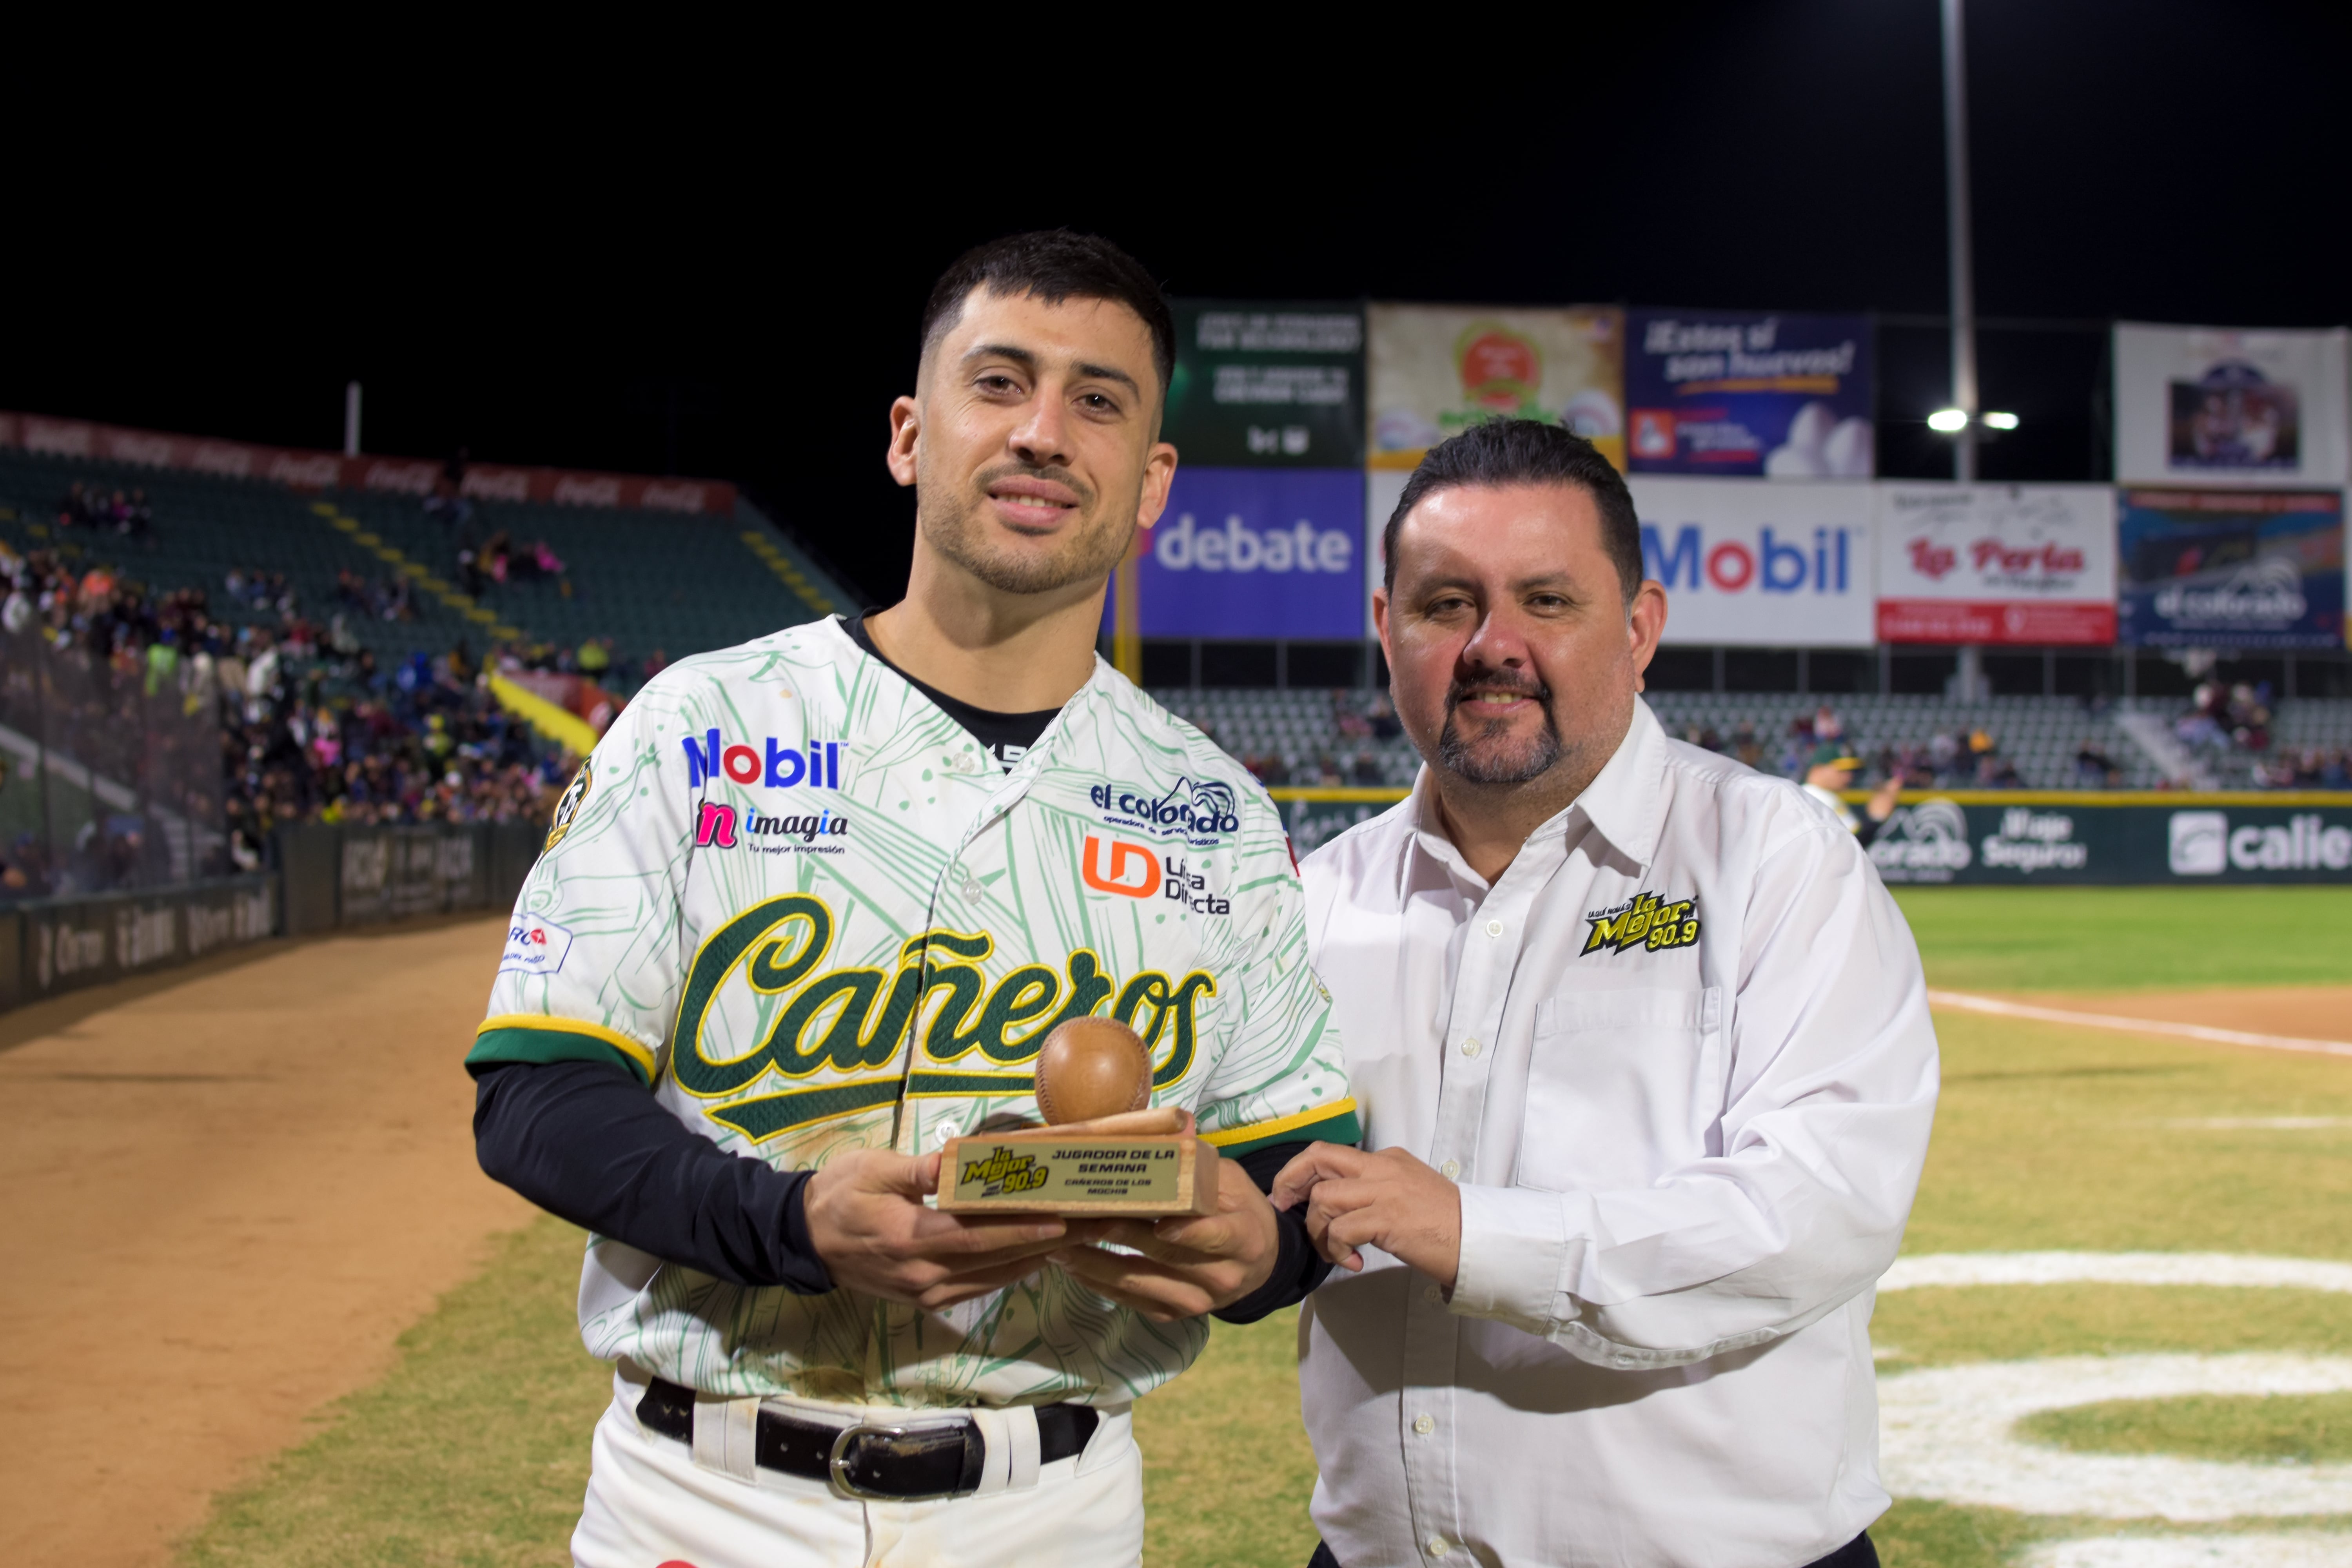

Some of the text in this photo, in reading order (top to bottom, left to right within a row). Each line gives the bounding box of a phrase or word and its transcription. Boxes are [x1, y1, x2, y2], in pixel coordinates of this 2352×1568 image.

[1157, 514, 1352, 572] debate
[1640, 525, 1849, 593] Mobil
[682, 728, 838, 789] Mobil
[1091, 784, 1239, 833] el colorado
[746, 808, 848, 842] imagia
[763, 845, 791, 855] mejor
[794, 844, 845, 854] impresión
[2229, 813, 2352, 870] calie
[1166, 857, 1205, 890] Lía
[1631, 892, 1660, 915] la
[1584, 901, 1693, 953] Mejor
[1646, 920, 1700, 951] 90.9
[671, 892, 1216, 1097] Cañeros
[961, 1154, 1035, 1185] Mejor
[993, 1146, 1014, 1162] la
[1052, 1150, 1175, 1159] JUGADOR DE LA
[1078, 1163, 1147, 1173] SEMANA
[1002, 1165, 1049, 1194] 90.9
[1064, 1178, 1113, 1186] CAÑEROS
